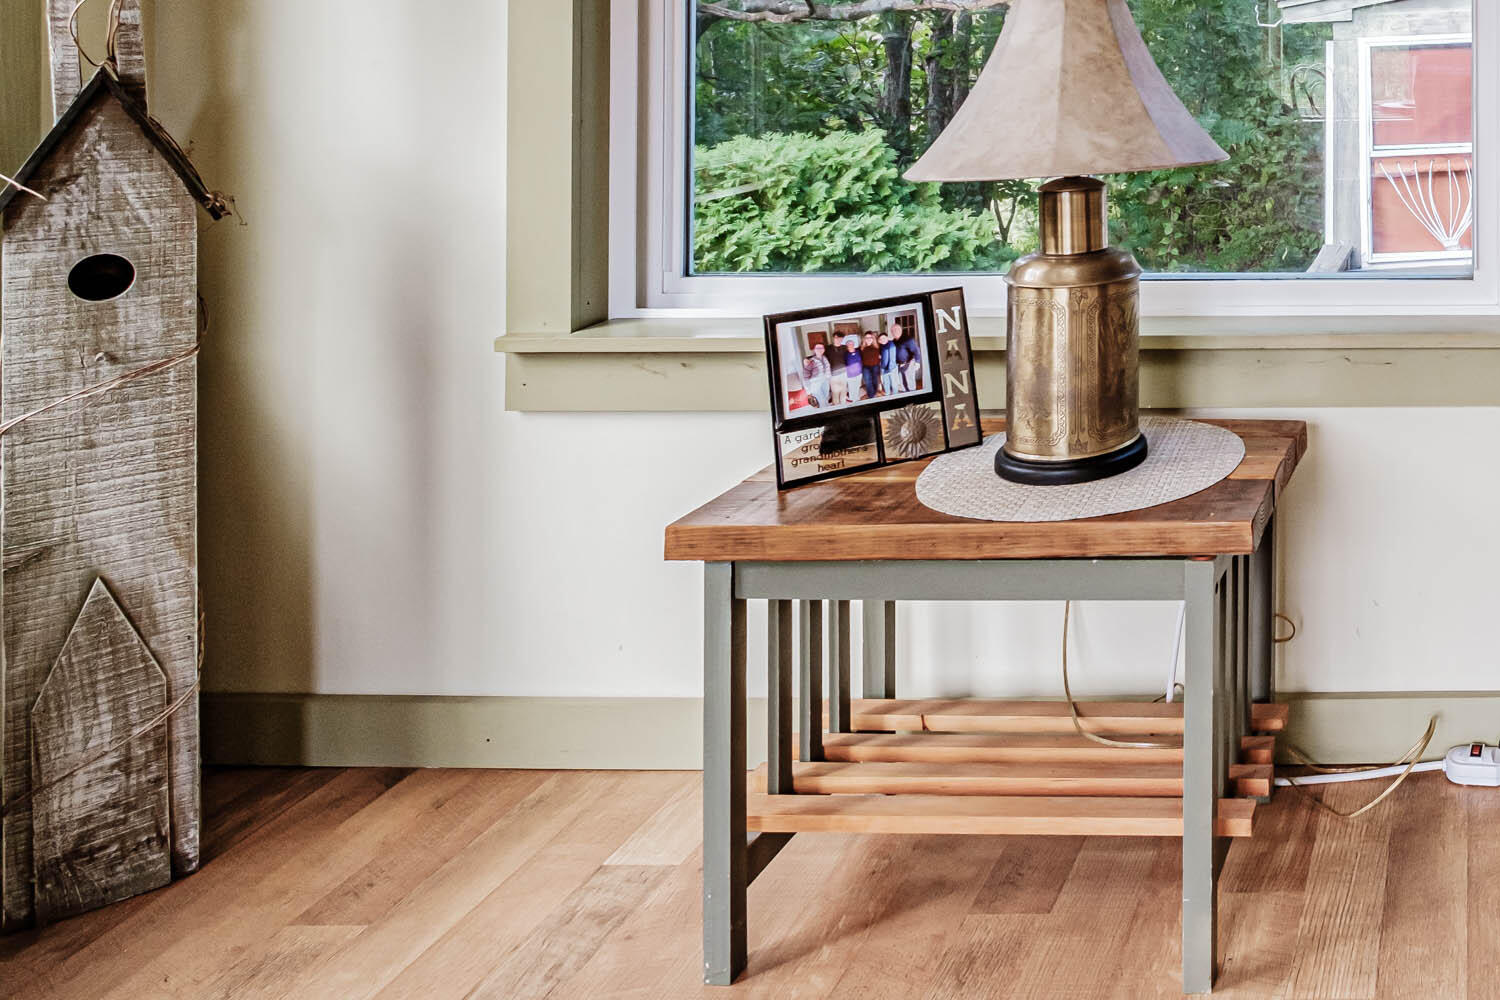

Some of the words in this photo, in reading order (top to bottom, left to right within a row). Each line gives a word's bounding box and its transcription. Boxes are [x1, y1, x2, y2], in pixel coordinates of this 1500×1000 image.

[935, 305, 974, 430] NANA
[784, 435, 792, 444] A
[795, 429, 822, 442] gard
[801, 443, 820, 453] gro
[817, 459, 845, 472] heart
